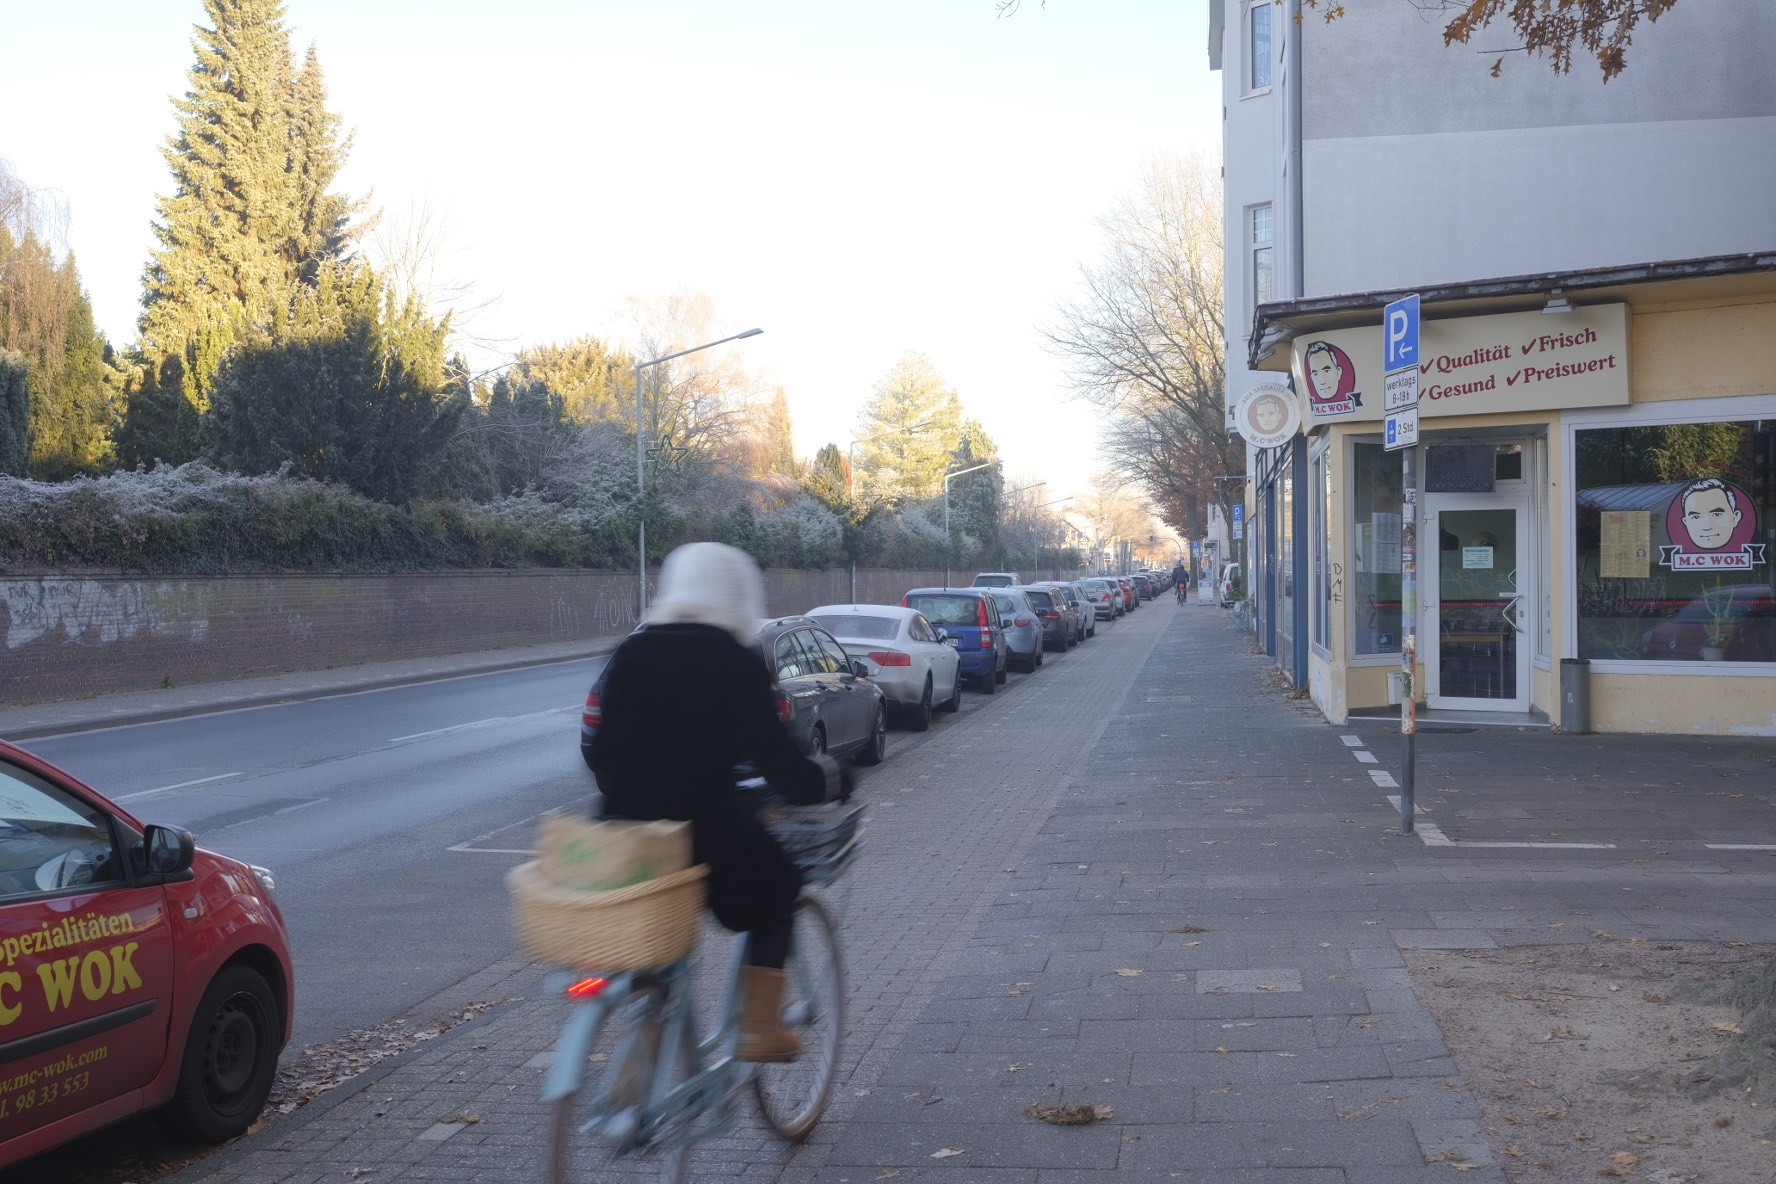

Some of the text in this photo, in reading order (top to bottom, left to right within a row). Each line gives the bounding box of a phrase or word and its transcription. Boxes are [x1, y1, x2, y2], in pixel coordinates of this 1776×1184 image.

[1389, 309, 1408, 363] P
[1436, 327, 1597, 374] Qualität Frisch
[1386, 376, 1416, 391] werktags
[1428, 354, 1616, 401] Gesund Preiswert
[1327, 402, 1351, 413] WOK
[1266, 432, 1288, 444] WOK
[1397, 421, 1415, 435] 2 Std.
[1234, 507, 1240, 520] P
[1678, 555, 1747, 566] M.C WOK
[0, 912, 135, 966] pezialitäten
[36, 942, 143, 1013] WOK
[15, 1089, 36, 1113] 98
[38, 1082, 58, 1106] 33
[62, 1071, 90, 1097] 553
